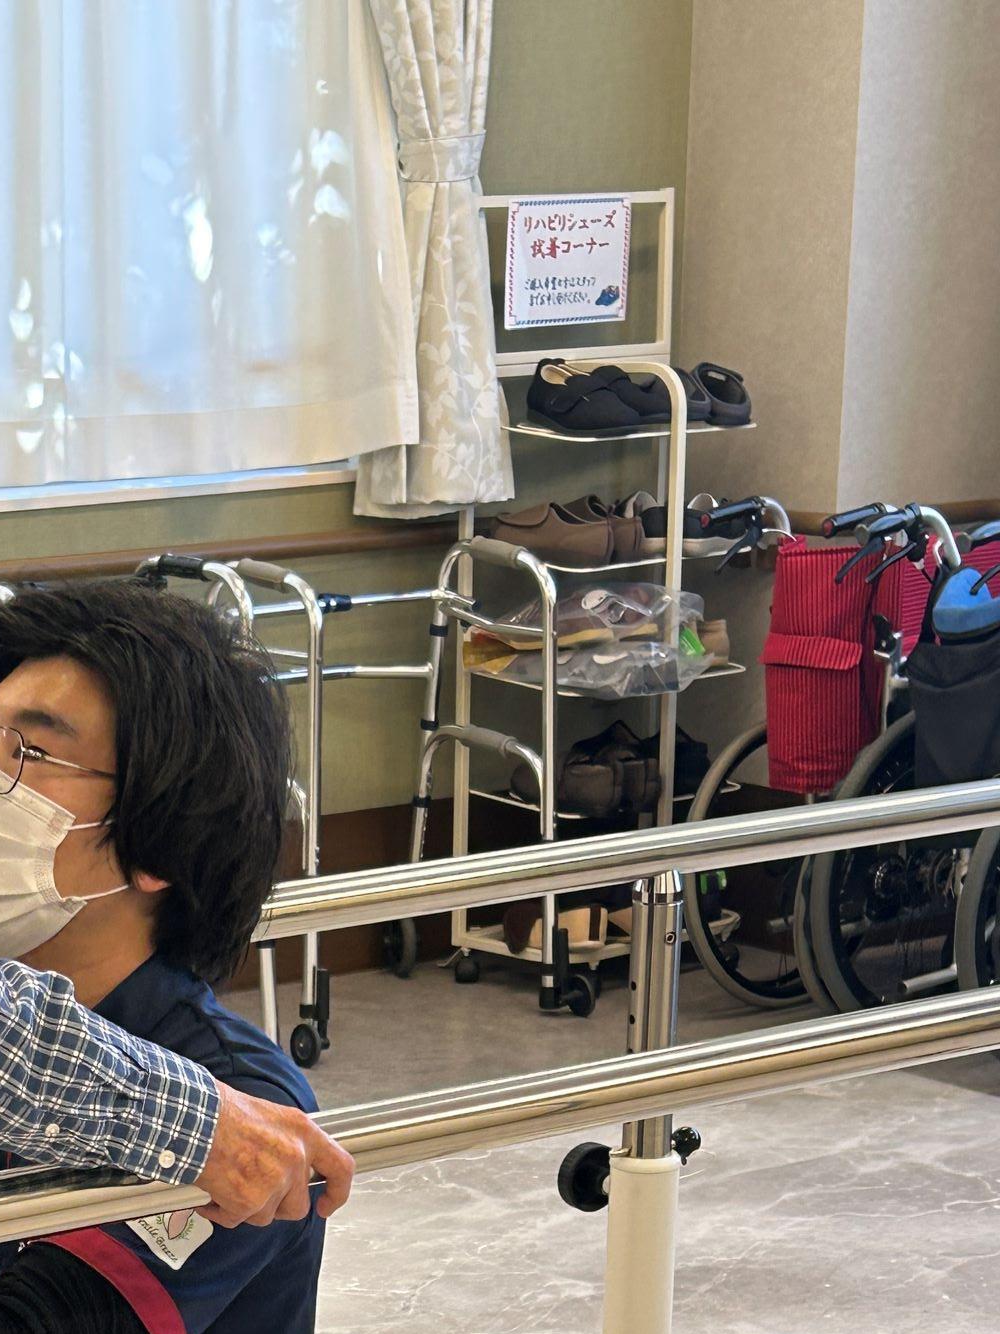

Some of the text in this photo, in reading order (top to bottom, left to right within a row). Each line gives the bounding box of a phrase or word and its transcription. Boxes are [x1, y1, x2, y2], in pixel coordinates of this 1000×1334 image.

[530, 236, 610, 259] 試着コーナー
